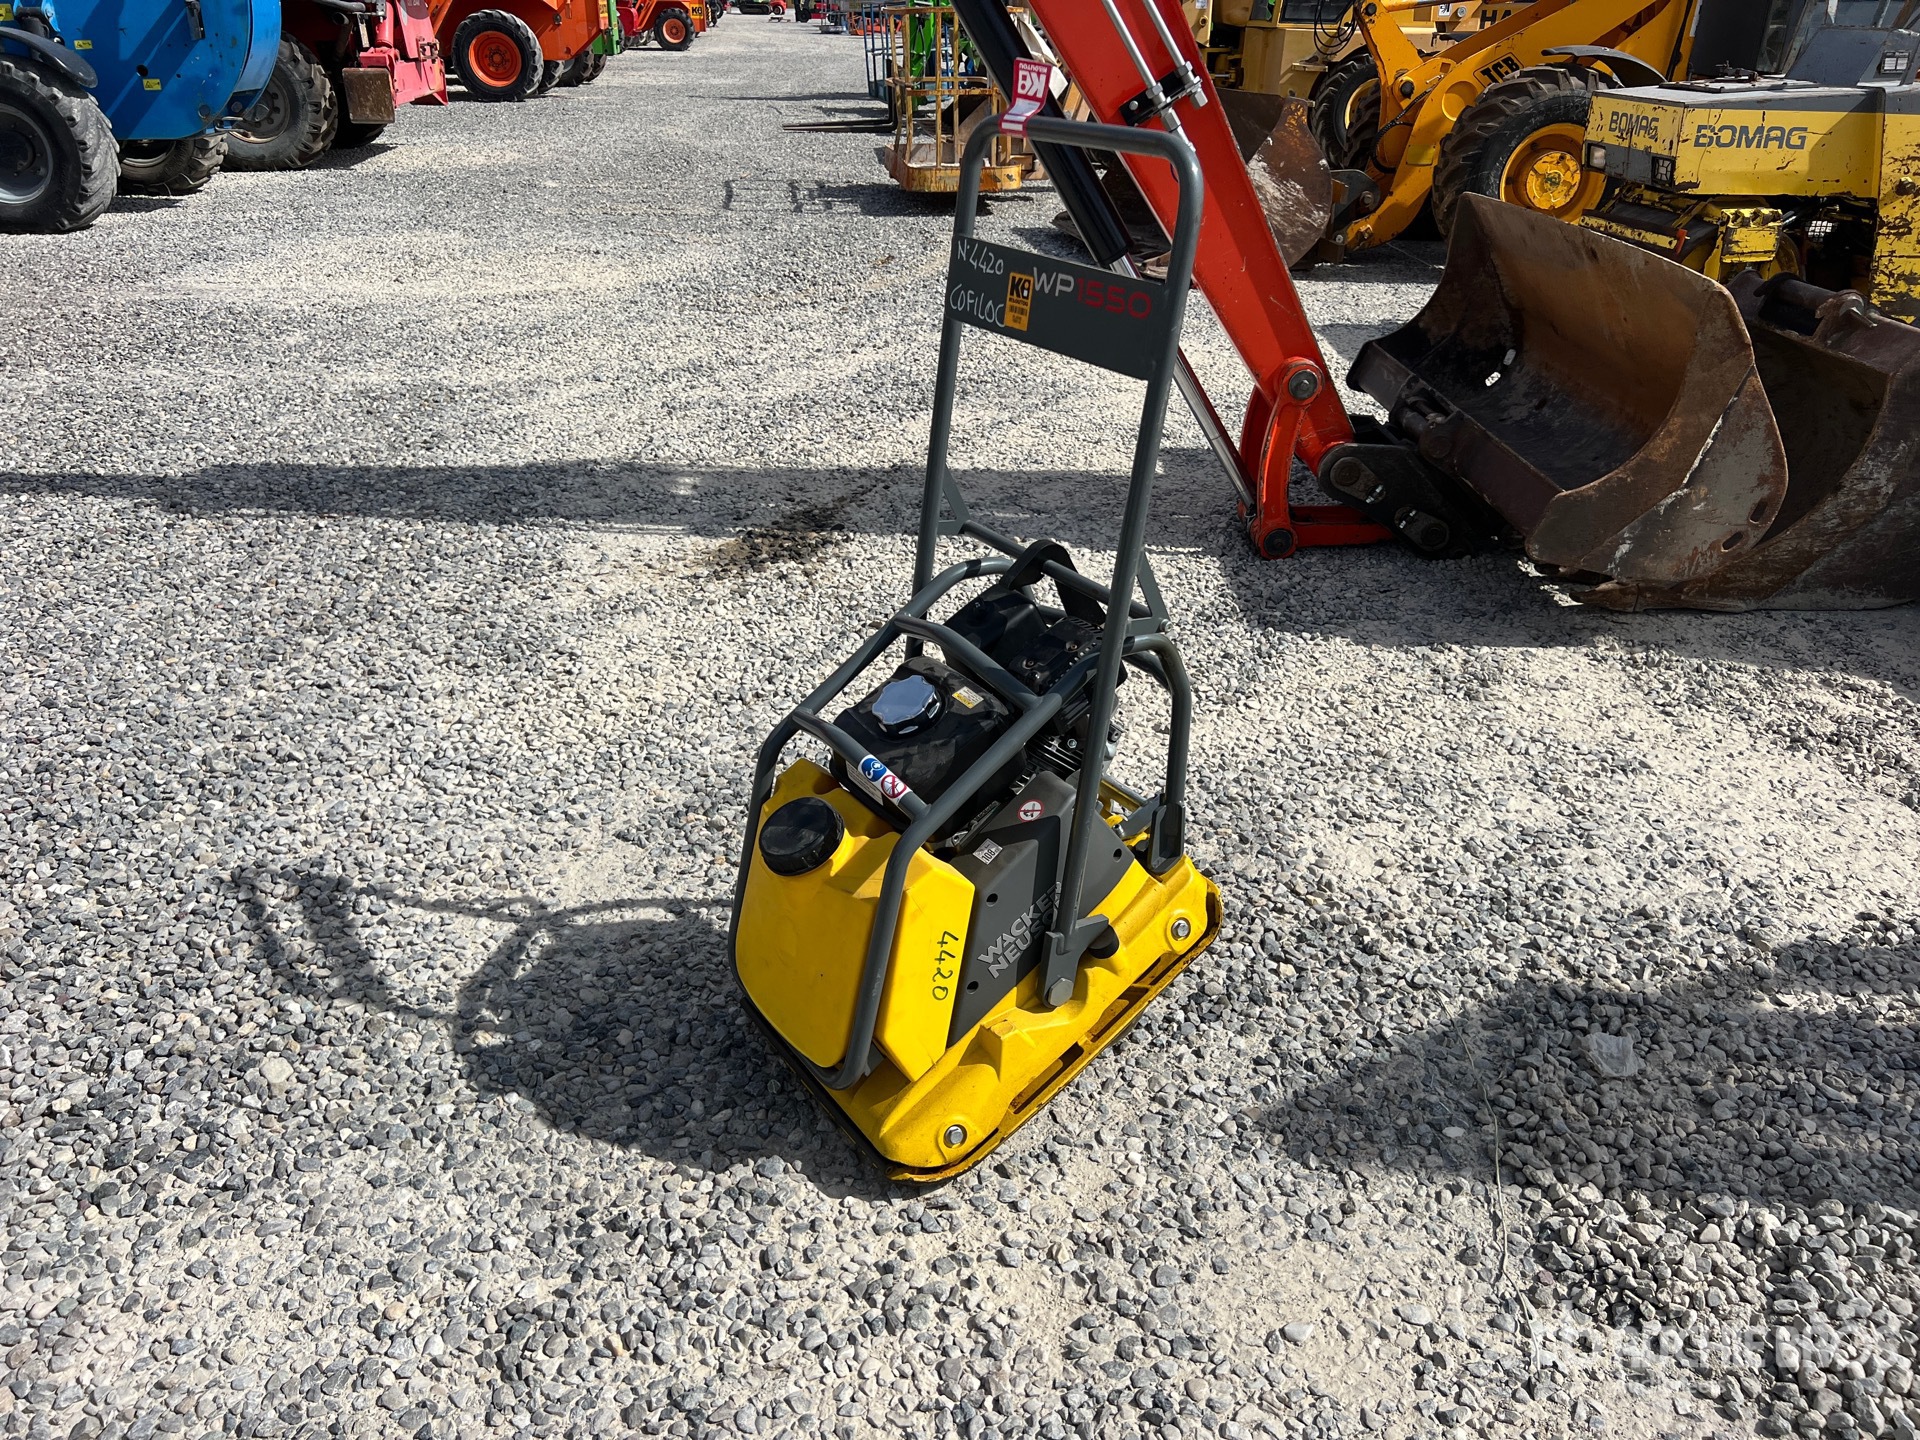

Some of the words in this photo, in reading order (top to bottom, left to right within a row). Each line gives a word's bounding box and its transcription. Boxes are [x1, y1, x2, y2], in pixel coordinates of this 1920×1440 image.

[1608, 111, 1659, 139] BOMAG
[1693, 124, 1808, 150] BOMAG
[981, 849, 996, 862] 108
[930, 930, 960, 1001] 4420
